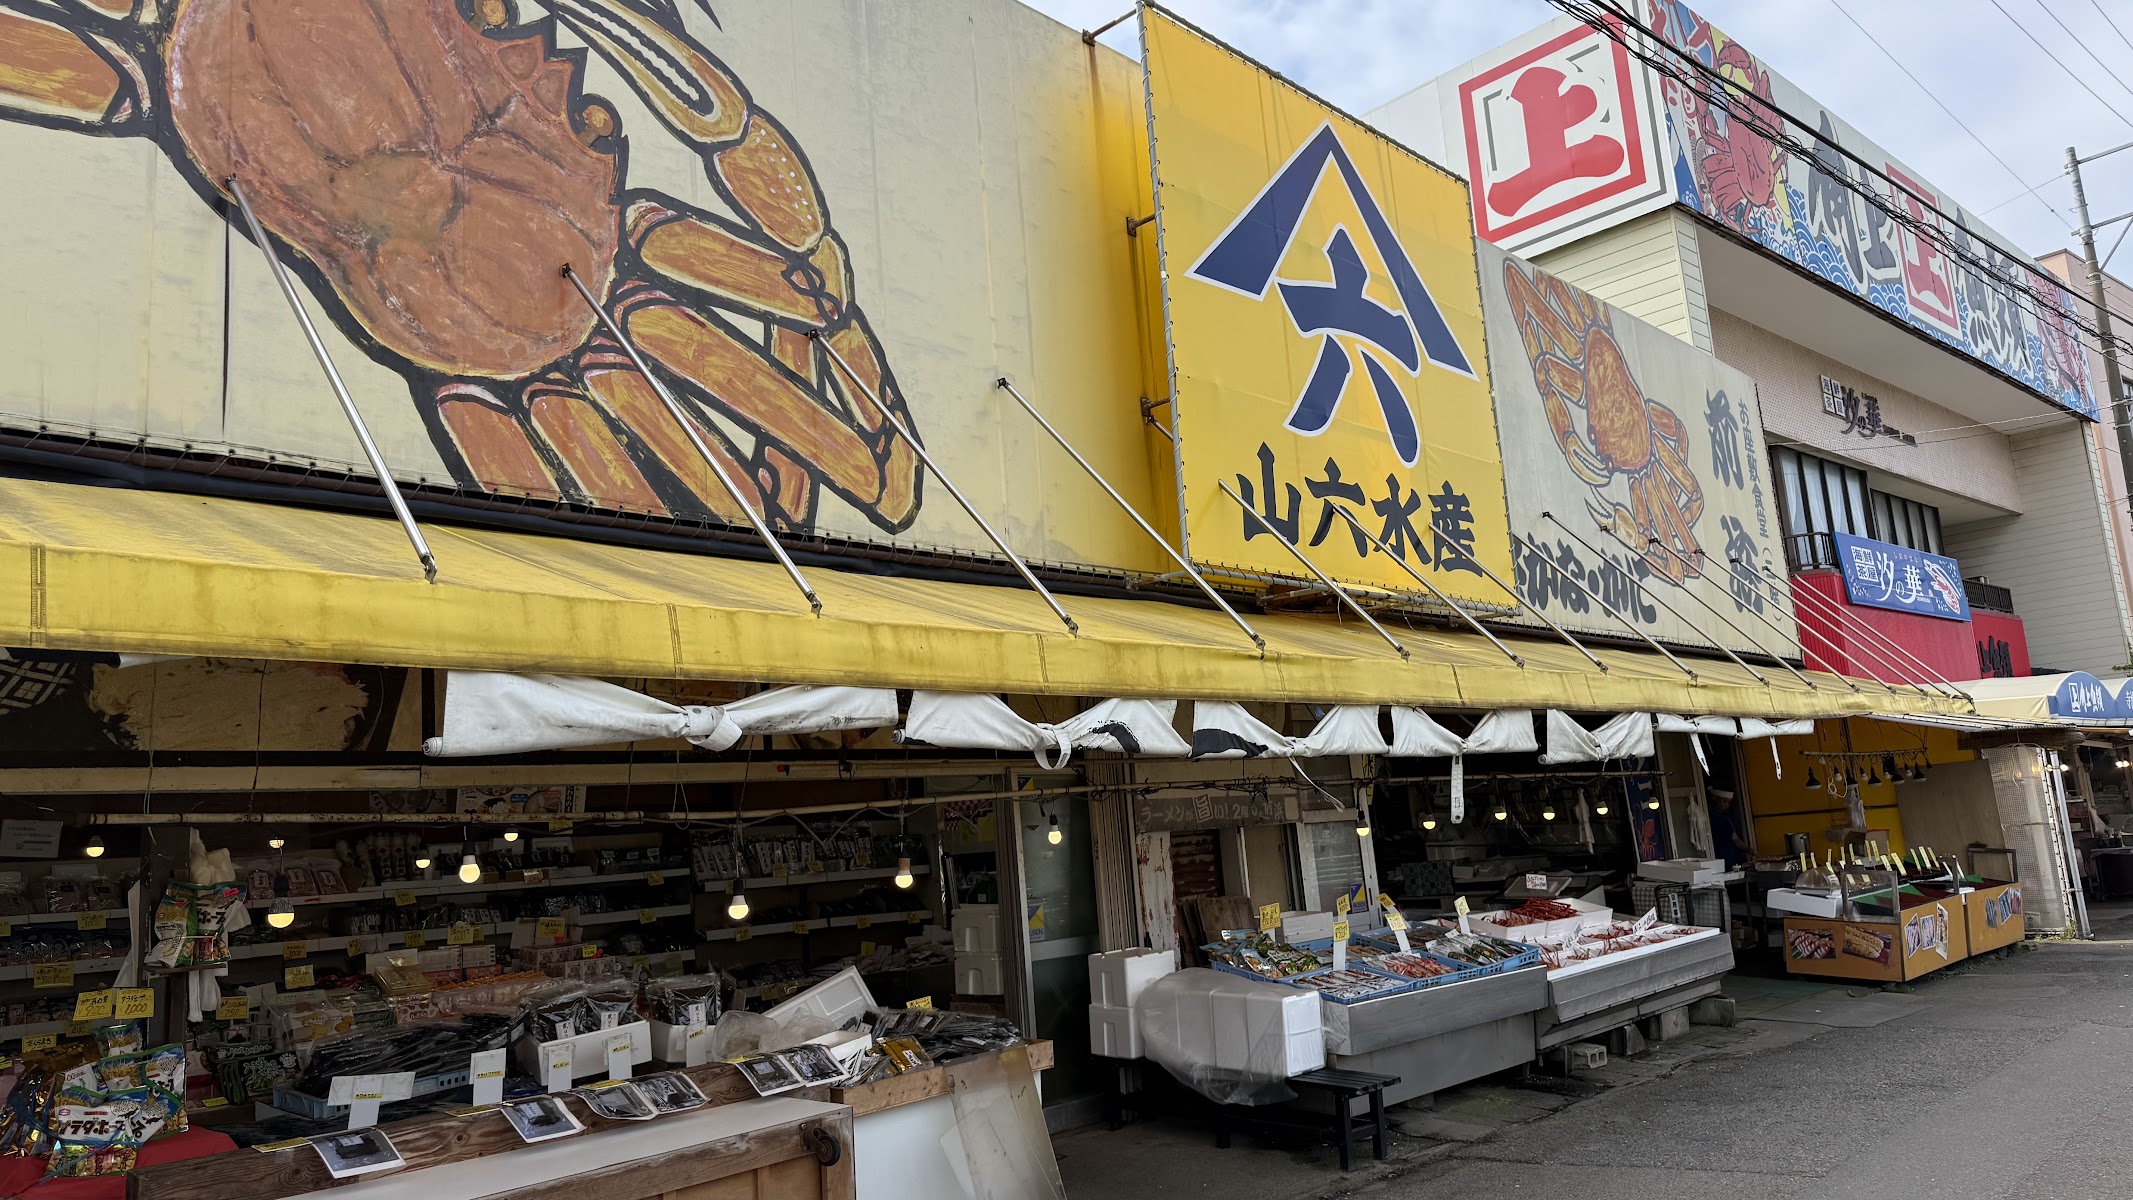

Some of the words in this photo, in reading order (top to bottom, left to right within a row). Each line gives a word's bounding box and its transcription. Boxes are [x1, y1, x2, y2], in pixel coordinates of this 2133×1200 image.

[1487, 66, 1625, 218] 上
[1236, 441, 1483, 578] 山六水産
[1852, 547, 1874, 566] 海鮮
[1856, 564, 1878, 582] 茶屋
[1876, 551, 1924, 604] 汐の華
